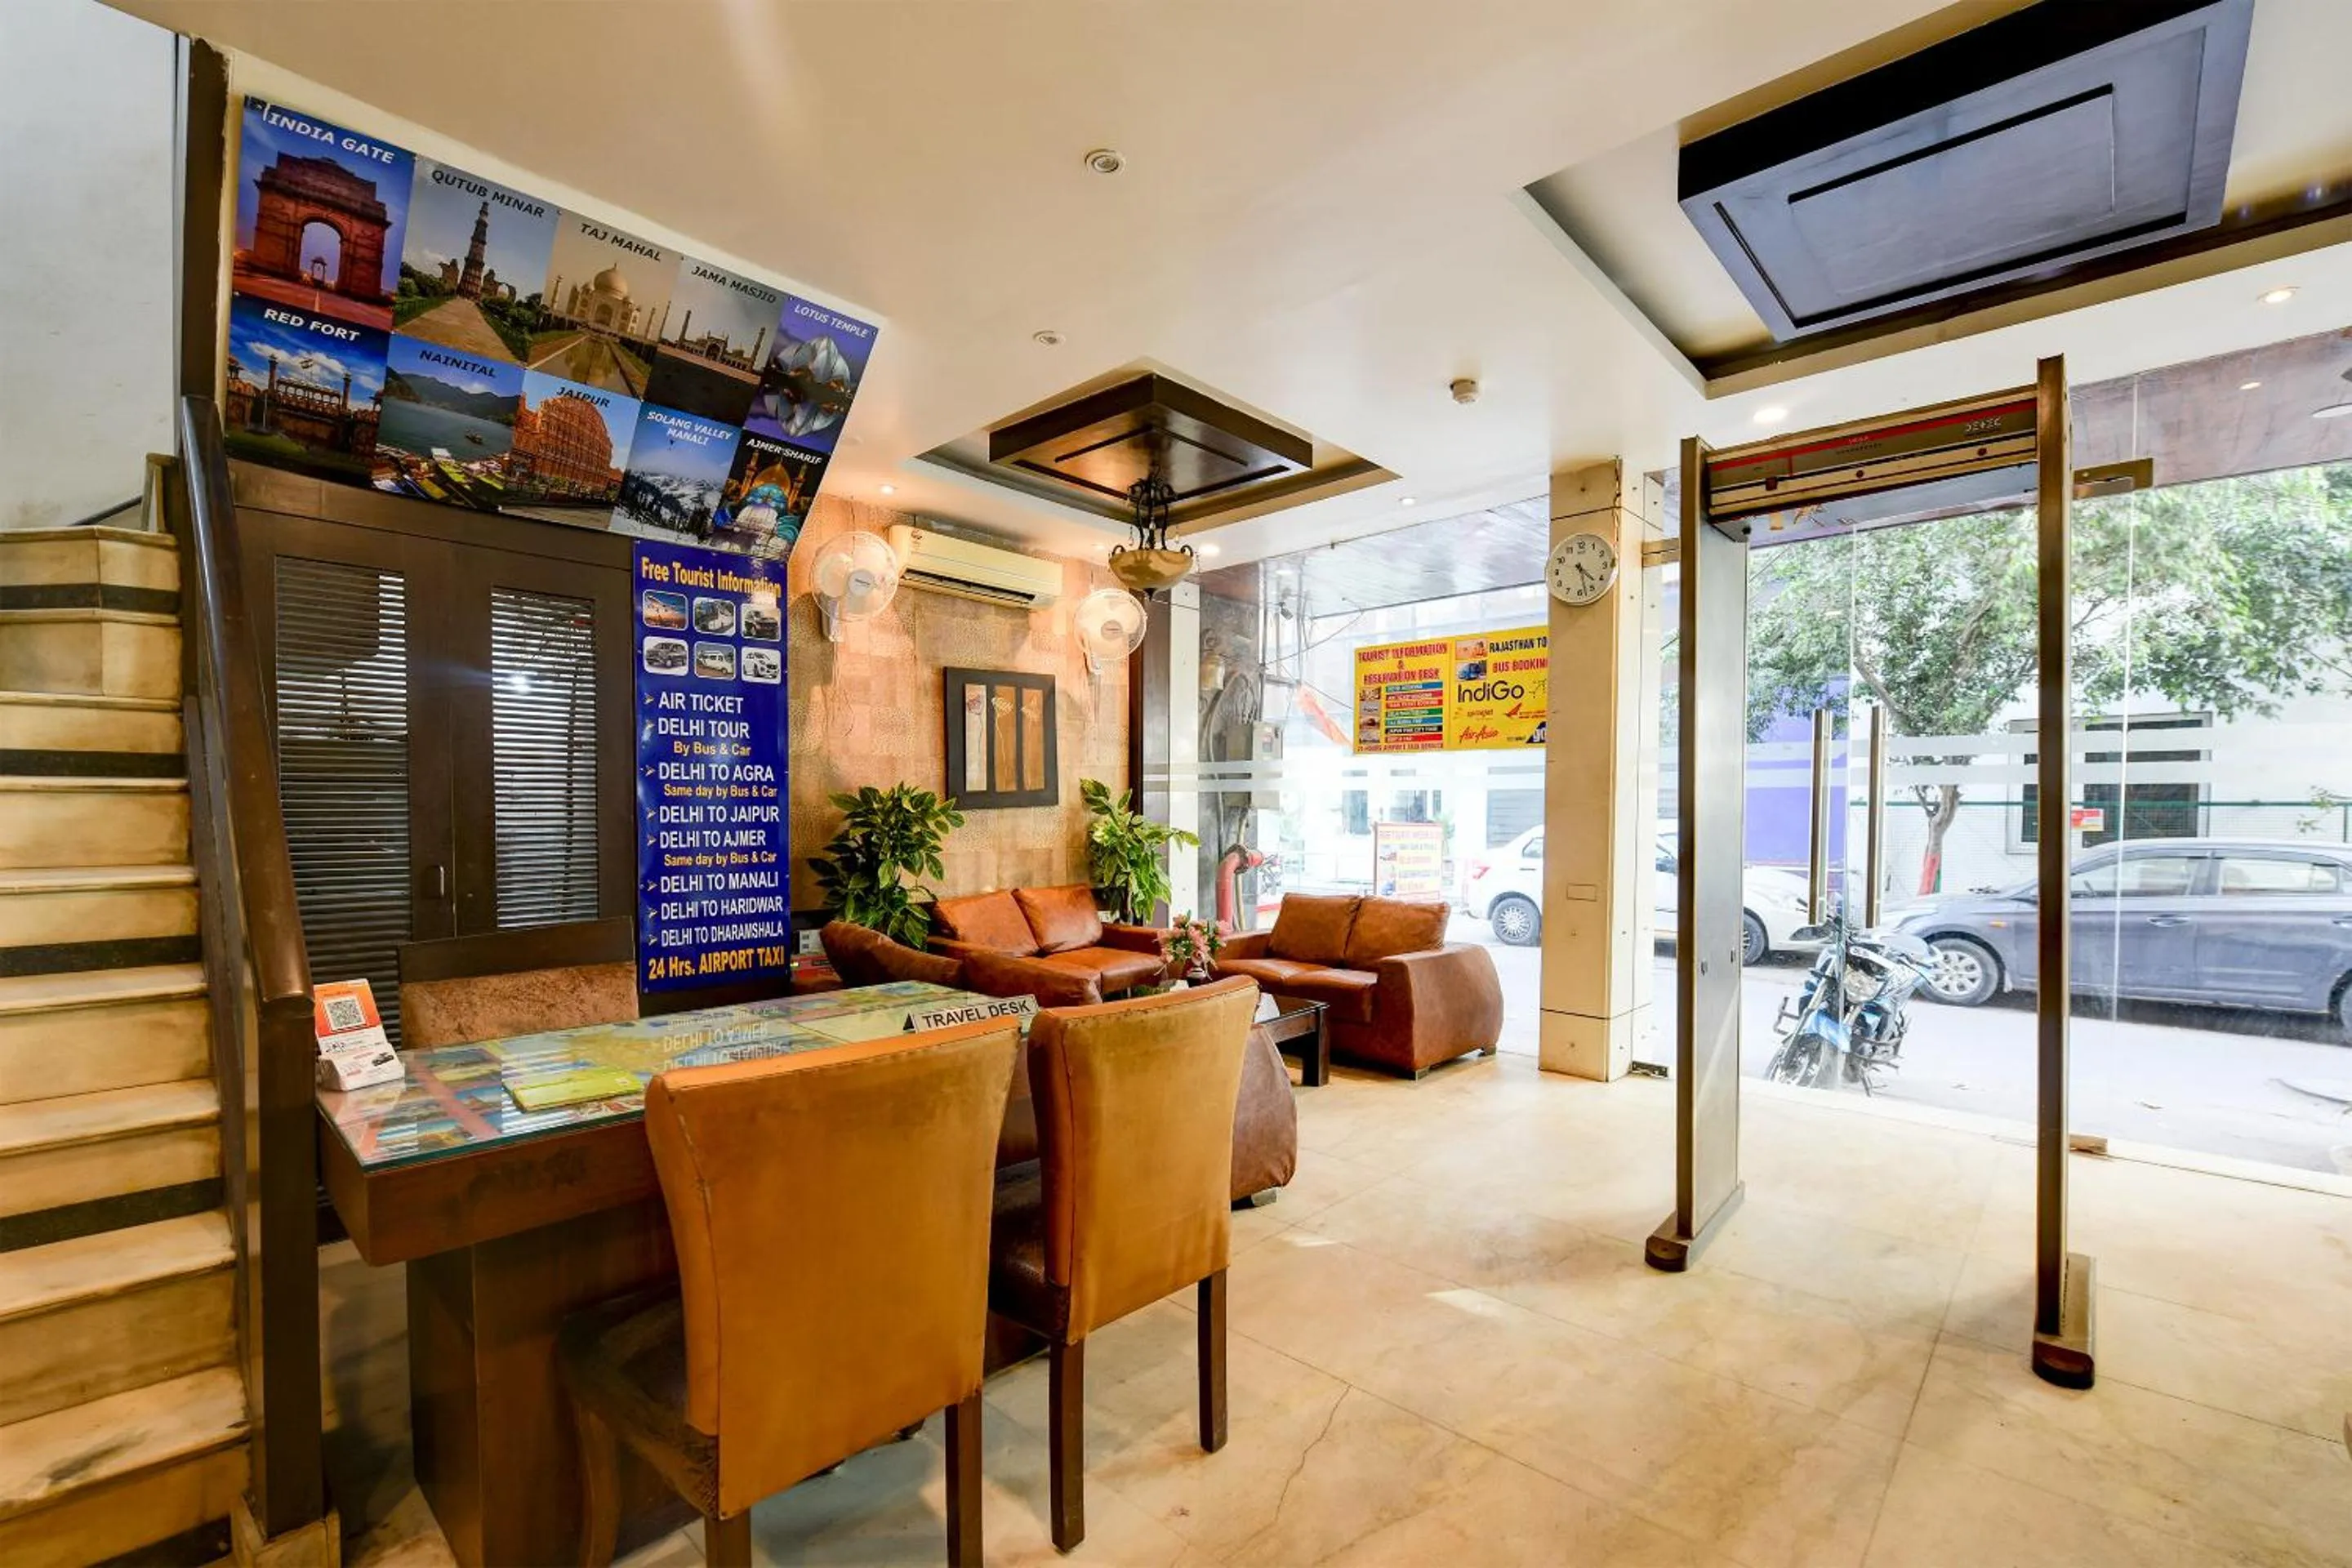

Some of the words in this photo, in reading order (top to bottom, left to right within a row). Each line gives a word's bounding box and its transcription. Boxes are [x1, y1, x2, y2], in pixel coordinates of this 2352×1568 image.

[268, 113, 335, 145] INDIA
[341, 137, 395, 163] GATE
[432, 170, 487, 198] QUTUB
[492, 191, 546, 218] MINAR
[581, 223, 608, 241] TAJ
[611, 234, 662, 262] MAHAL
[691, 266, 726, 286] JAMA
[730, 280, 777, 304] MASJID
[265, 308, 305, 327] RED
[309, 322, 360, 342] FORT
[794, 304, 829, 324] LOTUS
[831, 318, 870, 338] TEMPLE
[419, 350, 497, 378] NAINITAL
[556, 385, 611, 408] JAIPUR
[647, 411, 693, 430] SOLANG
[694, 423, 733, 439] VALLEY
[666, 427, 710, 446] MANALI
[746, 439, 782, 454] AJMER
[783, 448, 822, 464] SHARIF
[641, 557, 669, 581] Free
[673, 561, 714, 589] Tourist
[718, 569, 782, 598] Information
[1490, 639, 1534, 653] RAJASTHAN
[1493, 662, 1509, 673] BUS
[659, 692, 685, 710] AIR
[689, 694, 743, 713] TICKET
[1458, 680, 1525, 702] IndiGo
[658, 718, 705, 736] DELHI
[708, 721, 750, 738] TOUR
[674, 742, 688, 755] By
[694, 742, 715, 755] Bus
[721, 742, 728, 755] &
[732, 744, 751, 755] Car
[659, 763, 705, 781] DELHI
[710, 765, 729, 781] TO
[733, 765, 774, 782] AGRA
[664, 784, 692, 797] Same
[696, 785, 712, 799] day
[716, 786, 728, 800] by
[731, 786, 749, 797] Bus
[752, 786, 759, 797] &
[761, 786, 777, 797] Car
[659, 806, 703, 823] DELHI
[707, 806, 727, 822] TO
[731, 806, 779, 822] JAIPUR
[660, 831, 700, 849] DELHI
[703, 831, 720, 847] TO
[723, 831, 766, 847] AJMER
[664, 854, 692, 866] Same
[696, 853, 712, 867] day
[716, 853, 727, 867] by
[731, 852, 748, 863] Bus
[752, 852, 758, 863] &
[761, 851, 777, 863] Car
[661, 875, 703, 893] DELHI
[707, 874, 725, 891] TO
[728, 871, 778, 889] MANALI
[662, 902, 698, 920] DELHI
[702, 901, 718, 916] TO
[720, 896, 783, 915] HARIDWAR
[662, 929, 693, 947] DELHI
[695, 927, 709, 943] TO
[711, 921, 783, 943] DHARAMSHALA
[648, 958, 665, 980] 24
[669, 956, 695, 978] Hrs.
[699, 949, 755, 974] AIRPORT
[758, 946, 785, 966] TAXI
[922, 1008, 987, 1028] TRAVEL
[988, 1000, 1031, 1017] DESK
